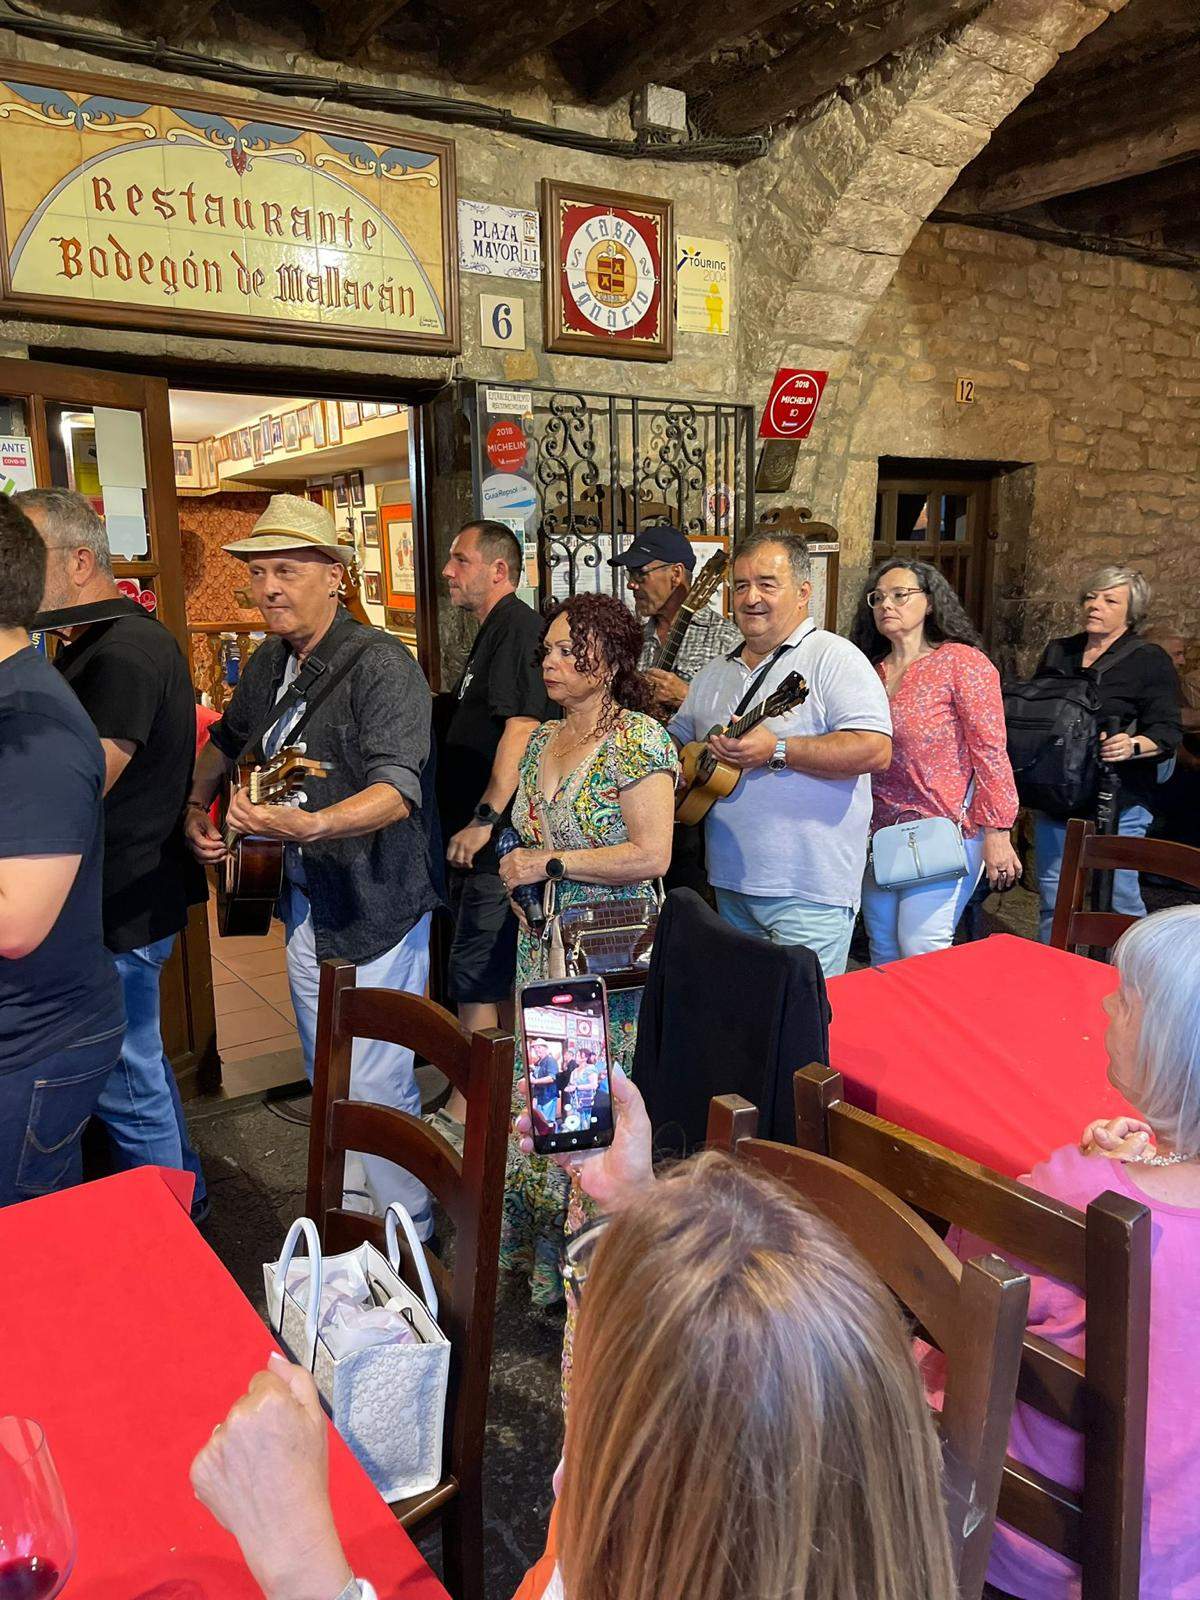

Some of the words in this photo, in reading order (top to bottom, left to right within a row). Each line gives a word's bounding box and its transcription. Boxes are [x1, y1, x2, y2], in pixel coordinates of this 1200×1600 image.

[92, 176, 377, 250] Restaurante
[473, 220, 518, 242] PLAZA
[471, 239, 521, 263] MAYOR
[524, 248, 537, 262] 11
[689, 257, 726, 271] TOURING
[49, 234, 223, 296] Bodegón
[231, 251, 265, 297] de
[274, 262, 416, 318] Mallacán
[703, 270, 727, 283] 2004
[492, 303, 512, 340] 6
[795, 380, 810, 389] 2018
[960, 379, 973, 402] 12
[781, 395, 813, 405] MICHELIN
[496, 427, 514, 436] 2018
[0, 443, 26, 454] ANTE
[487, 441, 526, 452] MICHELIN
